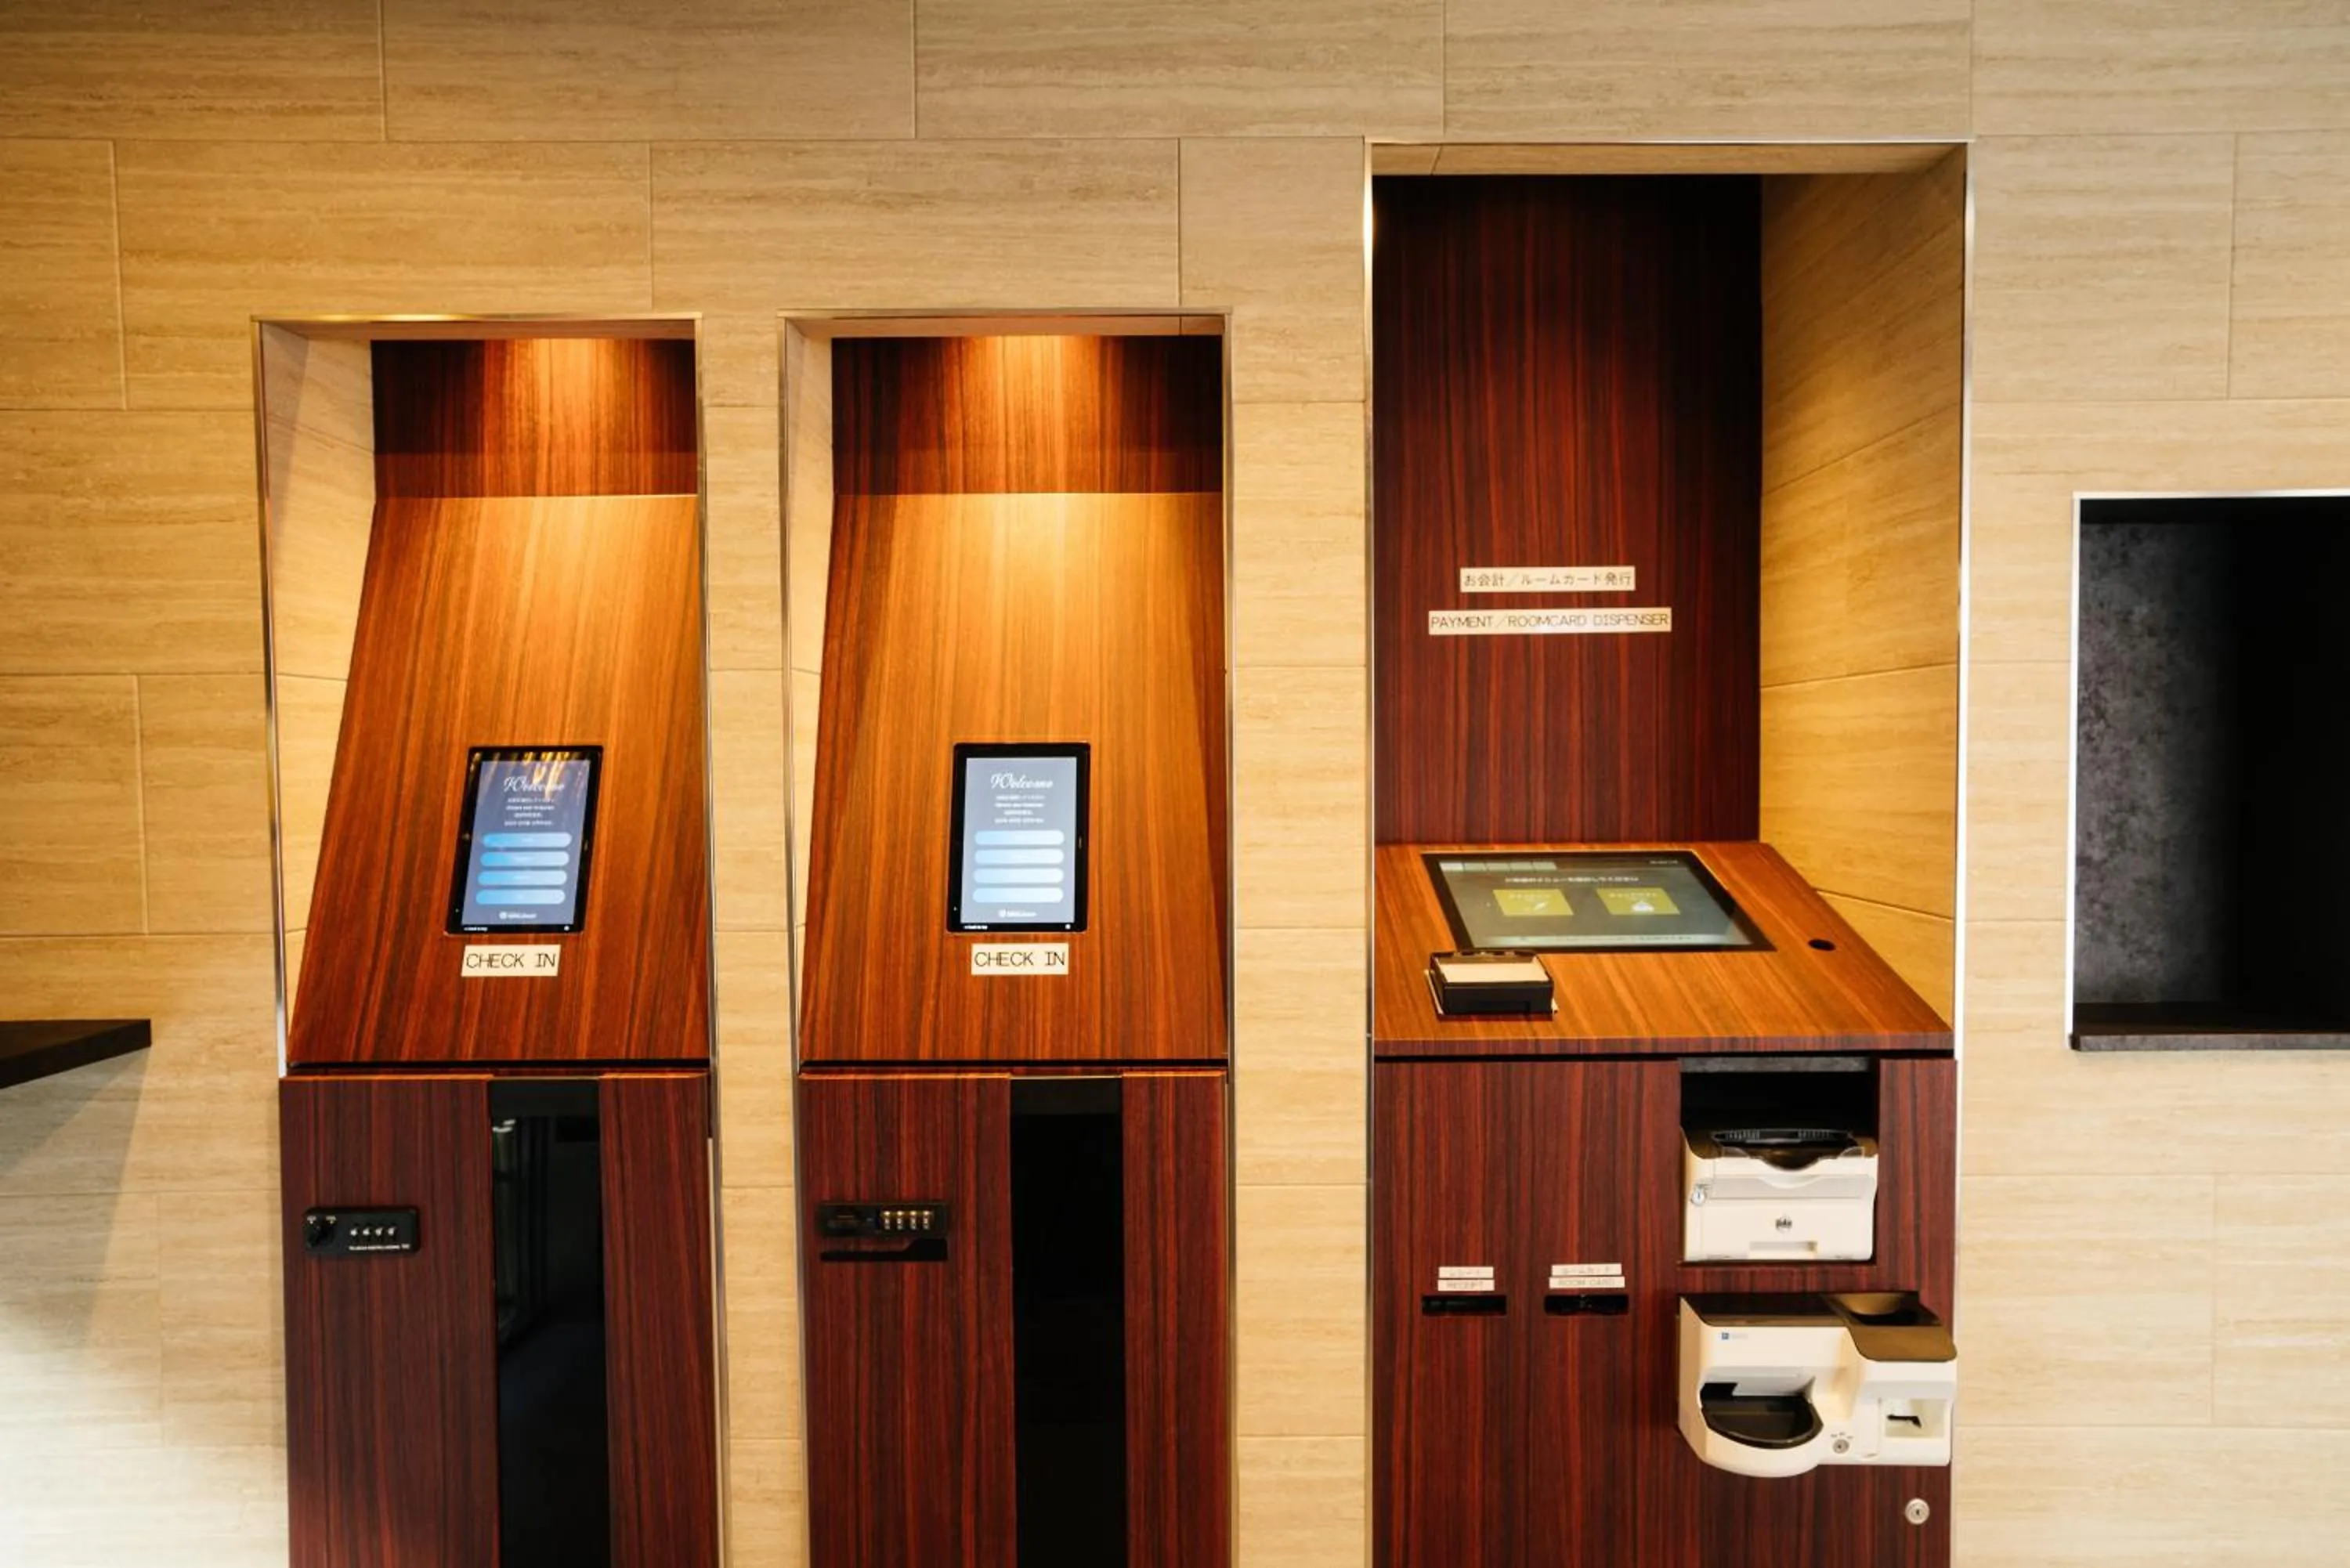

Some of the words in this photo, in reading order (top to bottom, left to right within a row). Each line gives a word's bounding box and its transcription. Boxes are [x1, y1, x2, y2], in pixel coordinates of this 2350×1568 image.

[1593, 612, 1668, 627] DISPENSER
[990, 772, 1053, 789] Welcome
[466, 952, 524, 968] CHECK
[536, 952, 556, 967] IN
[974, 951, 1034, 966] CHECK
[1045, 951, 1065, 966] IN
